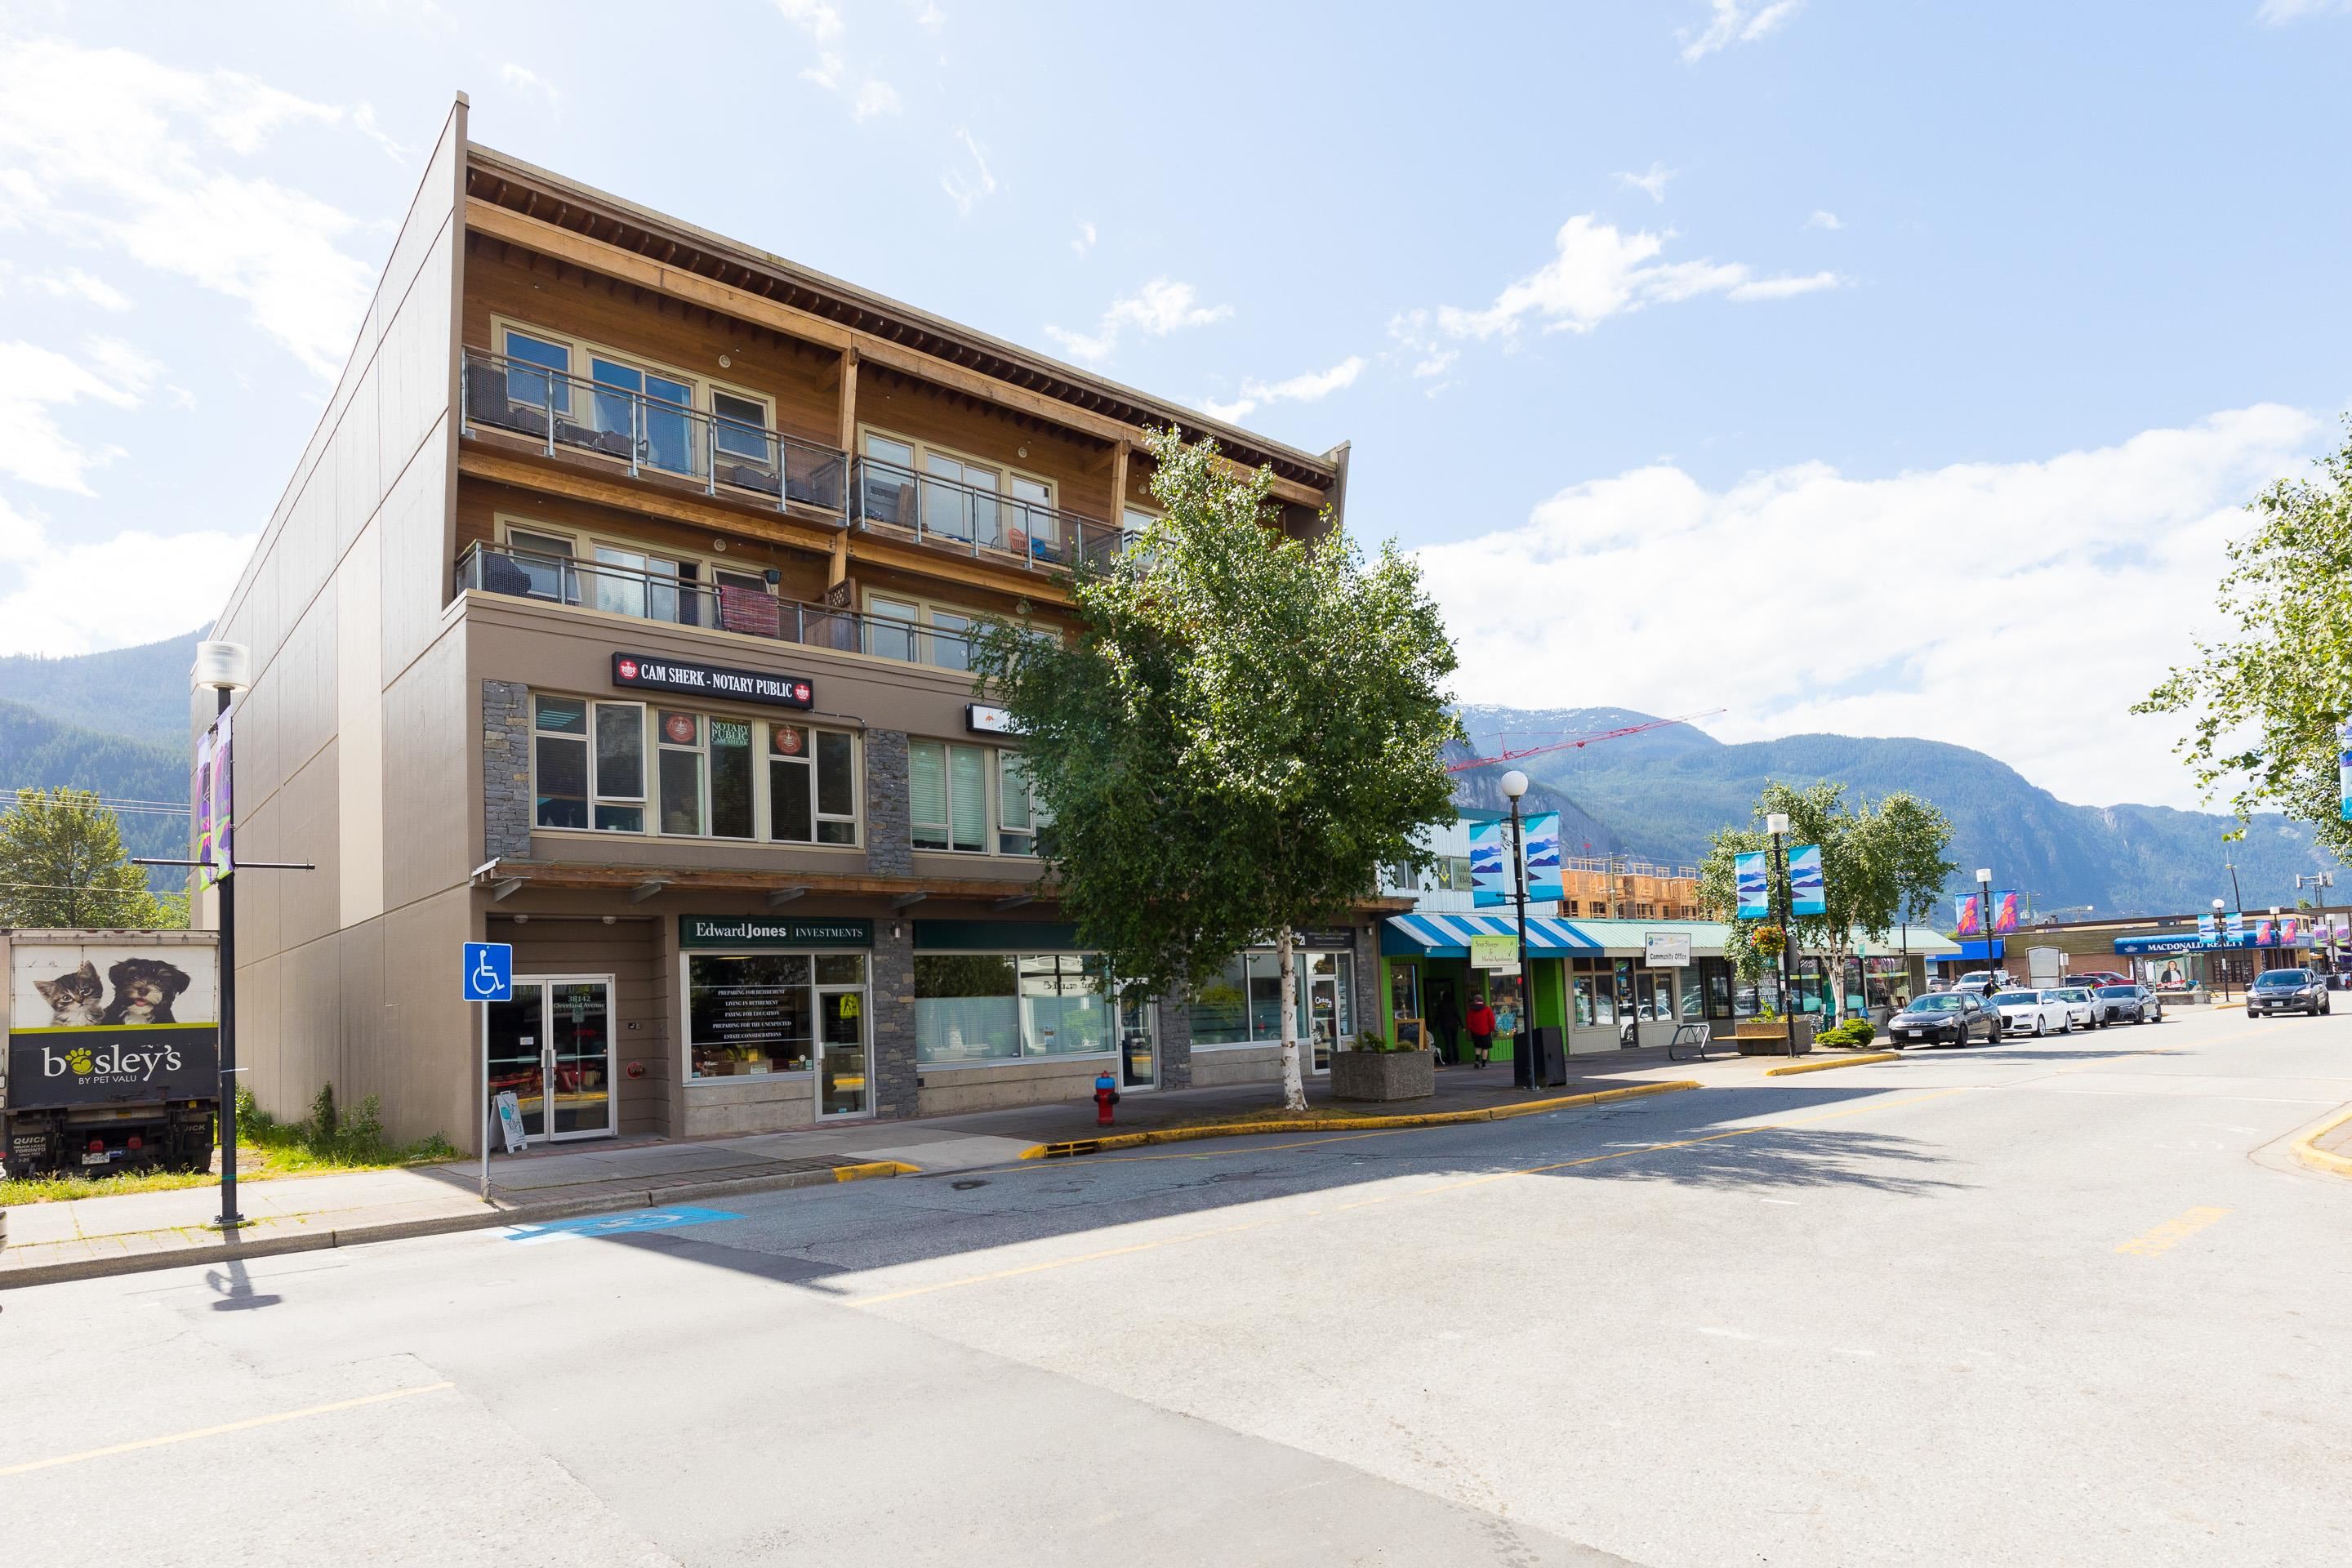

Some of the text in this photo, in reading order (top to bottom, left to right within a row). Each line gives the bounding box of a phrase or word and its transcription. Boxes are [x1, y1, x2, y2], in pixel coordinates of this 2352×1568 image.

[641, 664, 666, 681] CAM
[669, 667, 705, 686] SHERK
[713, 674, 754, 693] NOTARY
[756, 680, 792, 697] PUBLIC
[711, 722, 749, 733] NOTARY
[711, 729, 748, 741] PUBLIC
[795, 928, 863, 938] INVESTMENTS
[2148, 941, 2203, 951] MACDONALD
[1674, 952, 1686, 960] Office
[94, 1076, 109, 1084] PET
[112, 1075, 136, 1083] VALU
[13, 1136, 46, 1144] QUICK
